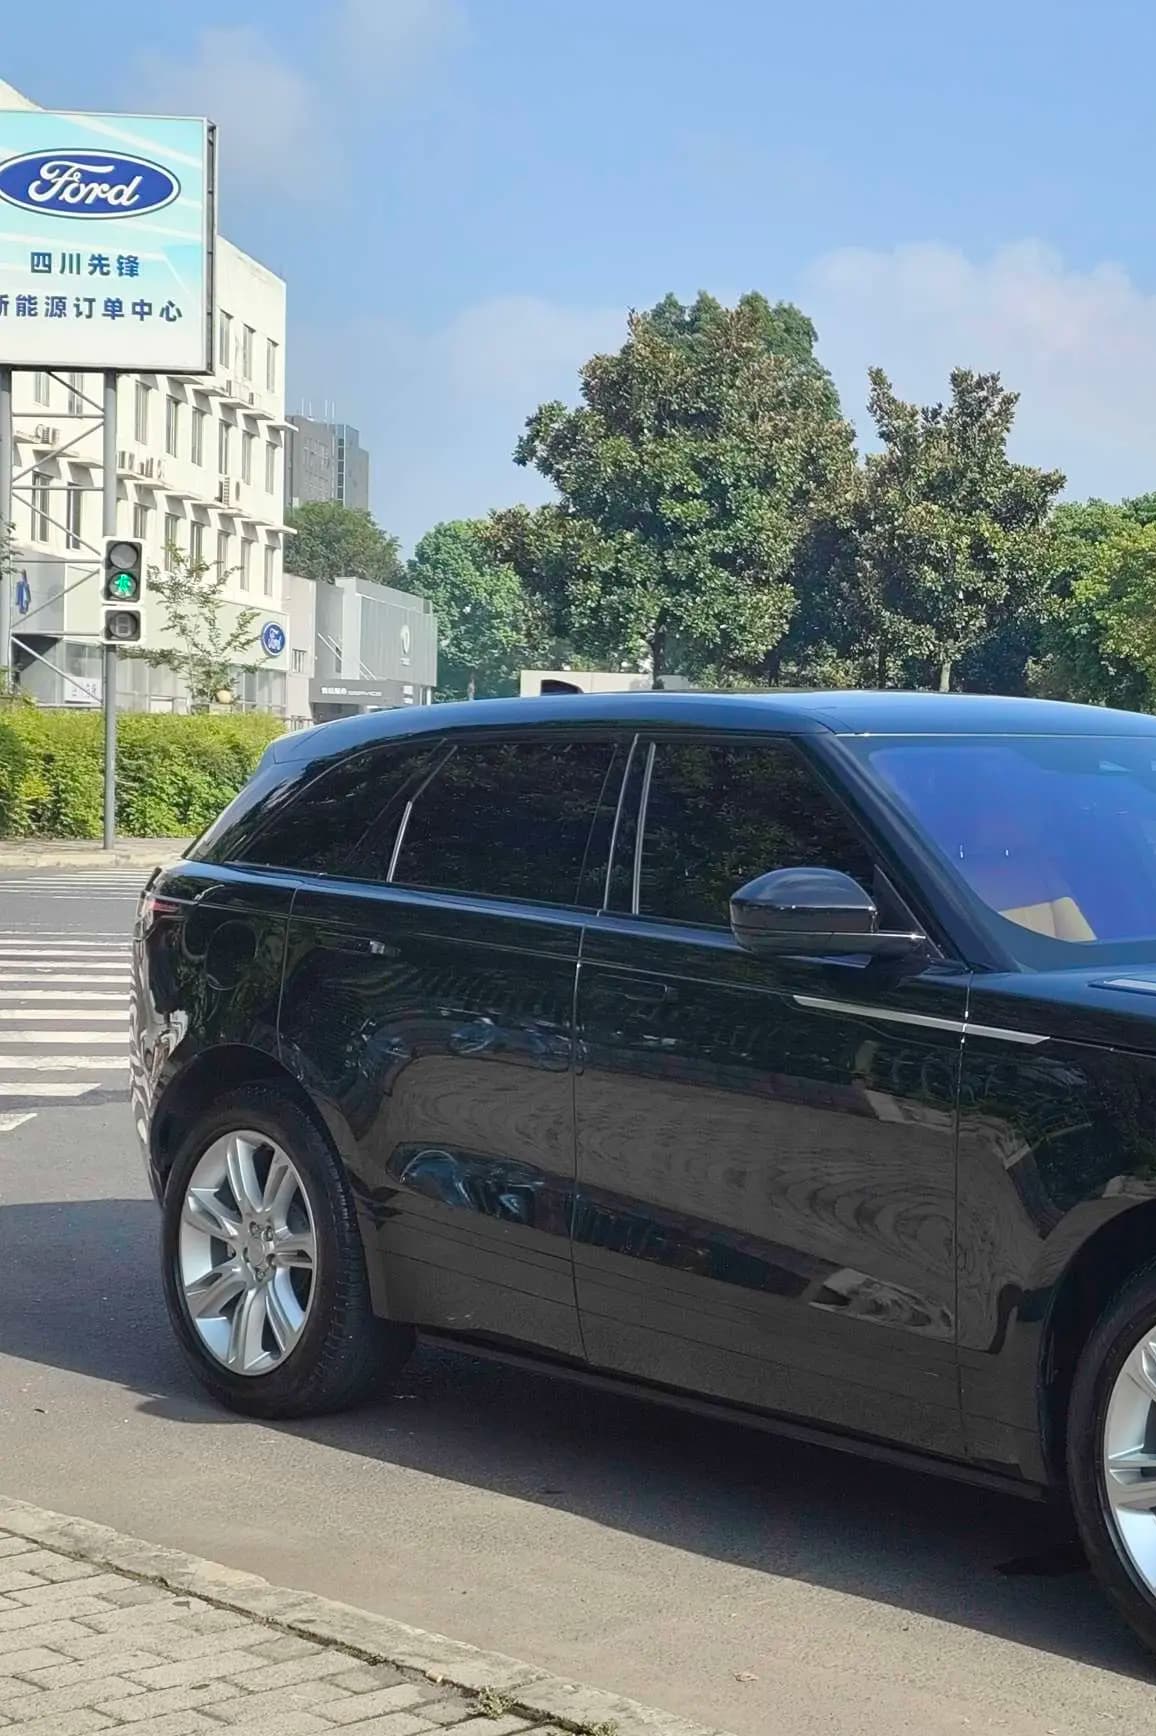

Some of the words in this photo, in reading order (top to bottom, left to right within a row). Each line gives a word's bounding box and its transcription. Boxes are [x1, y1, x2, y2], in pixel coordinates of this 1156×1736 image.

[28, 161, 143, 206] Ford
[31, 252, 140, 277] 四川先锋
